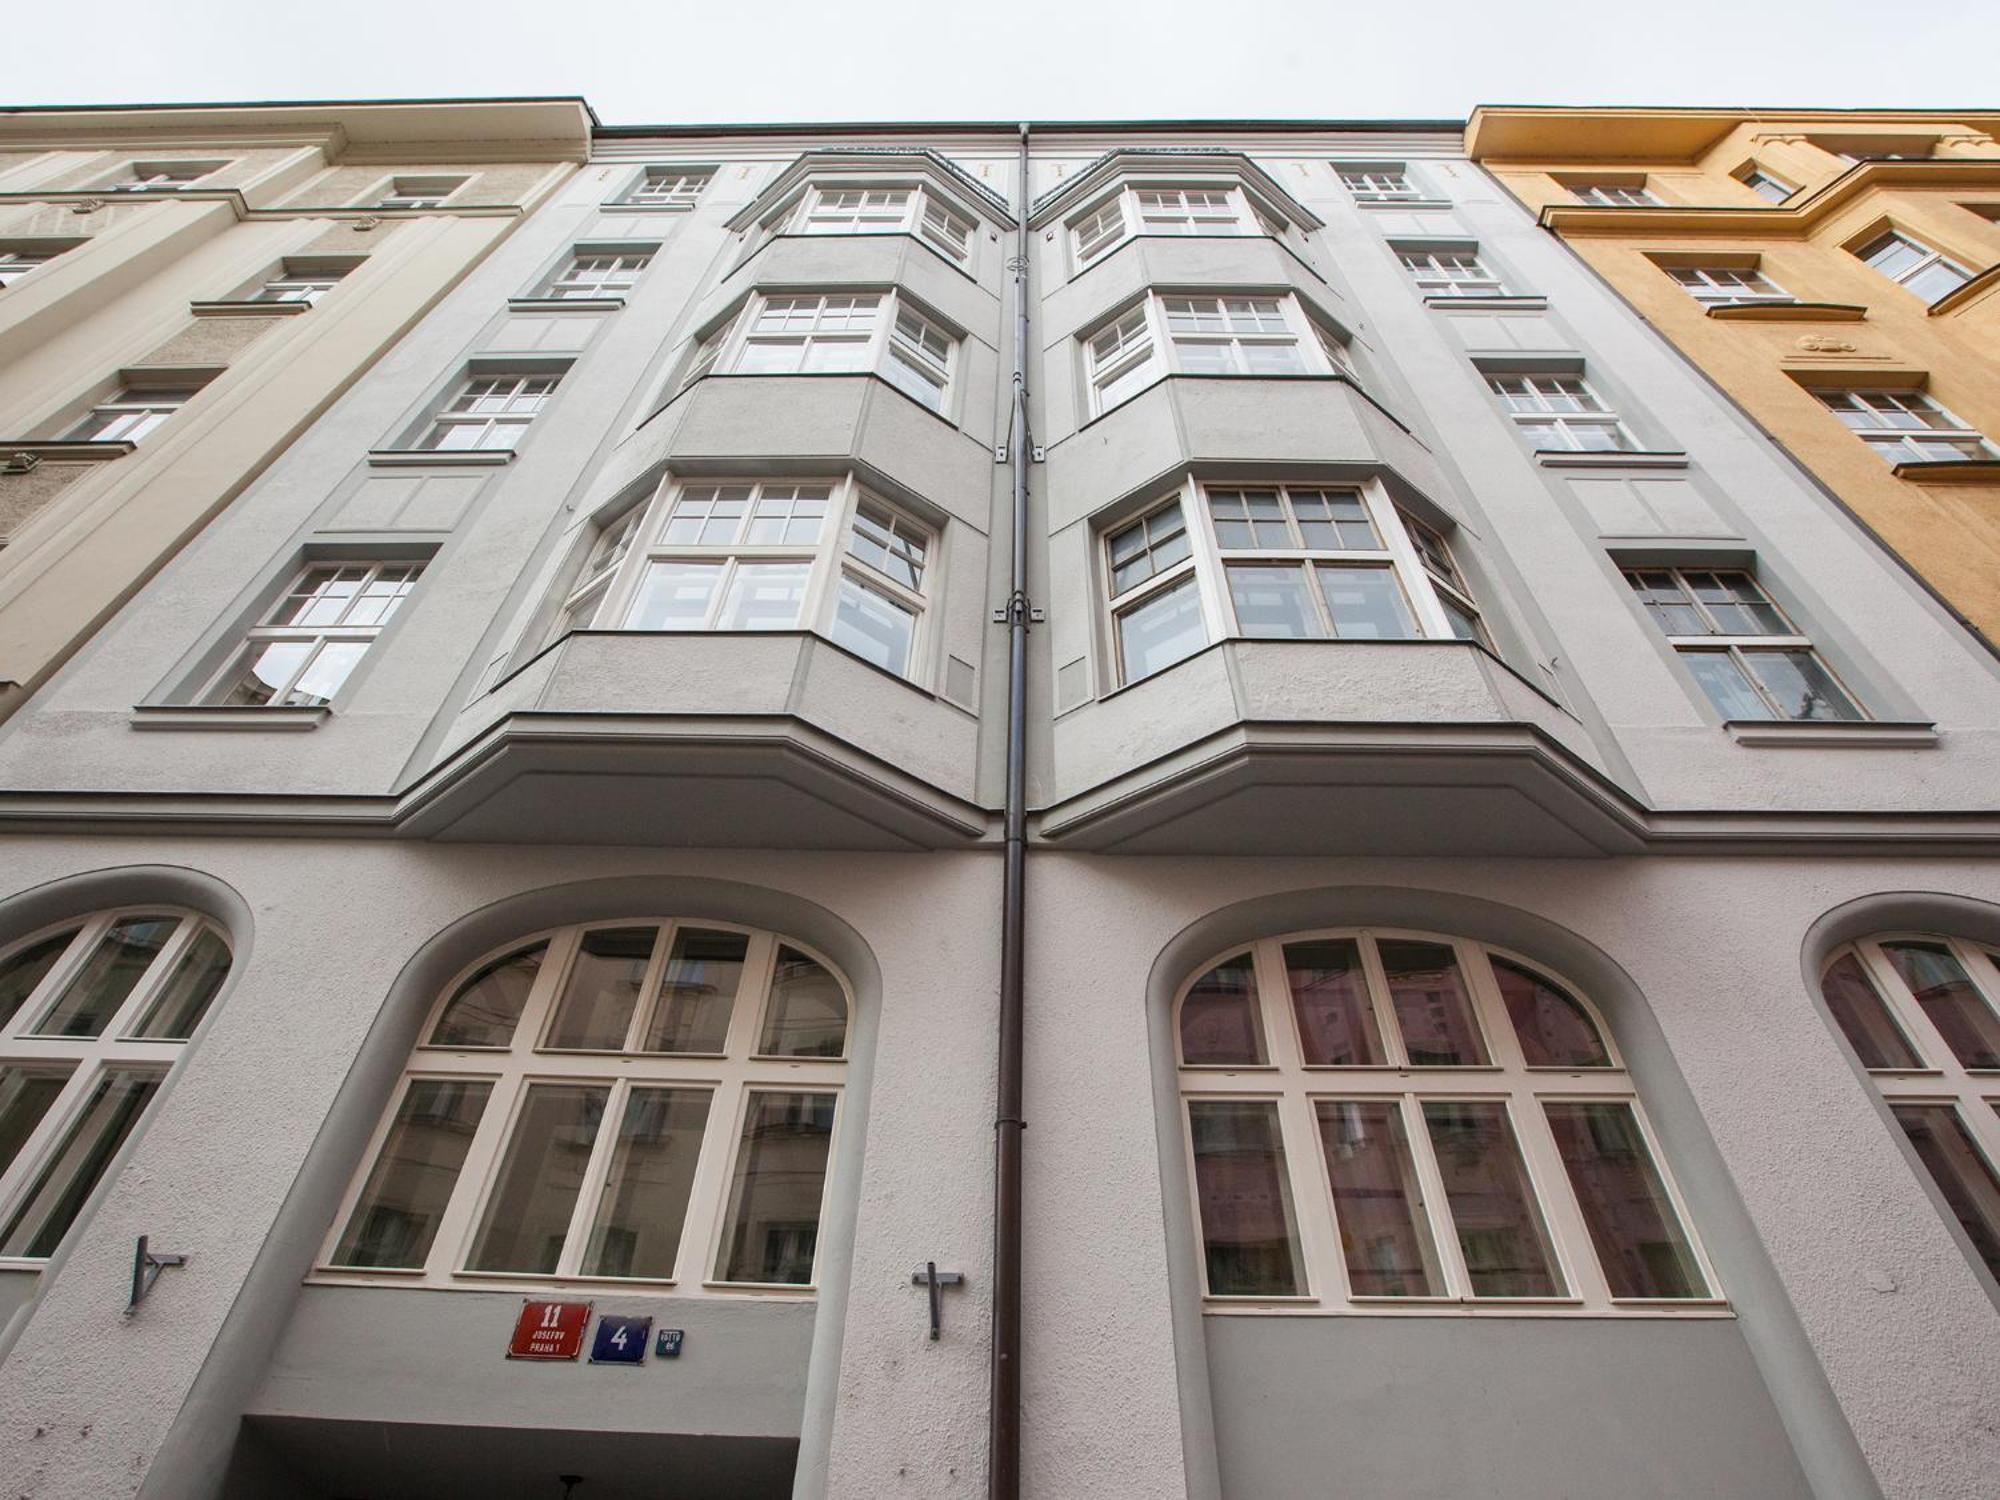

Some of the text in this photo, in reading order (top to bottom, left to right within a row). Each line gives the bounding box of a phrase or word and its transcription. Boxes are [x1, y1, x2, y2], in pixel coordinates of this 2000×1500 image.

[541, 1305, 562, 1327] 11
[532, 1330, 565, 1340] JOSEFOV
[610, 1325, 628, 1351] 4
[529, 1342, 554, 1352] PRAHA
